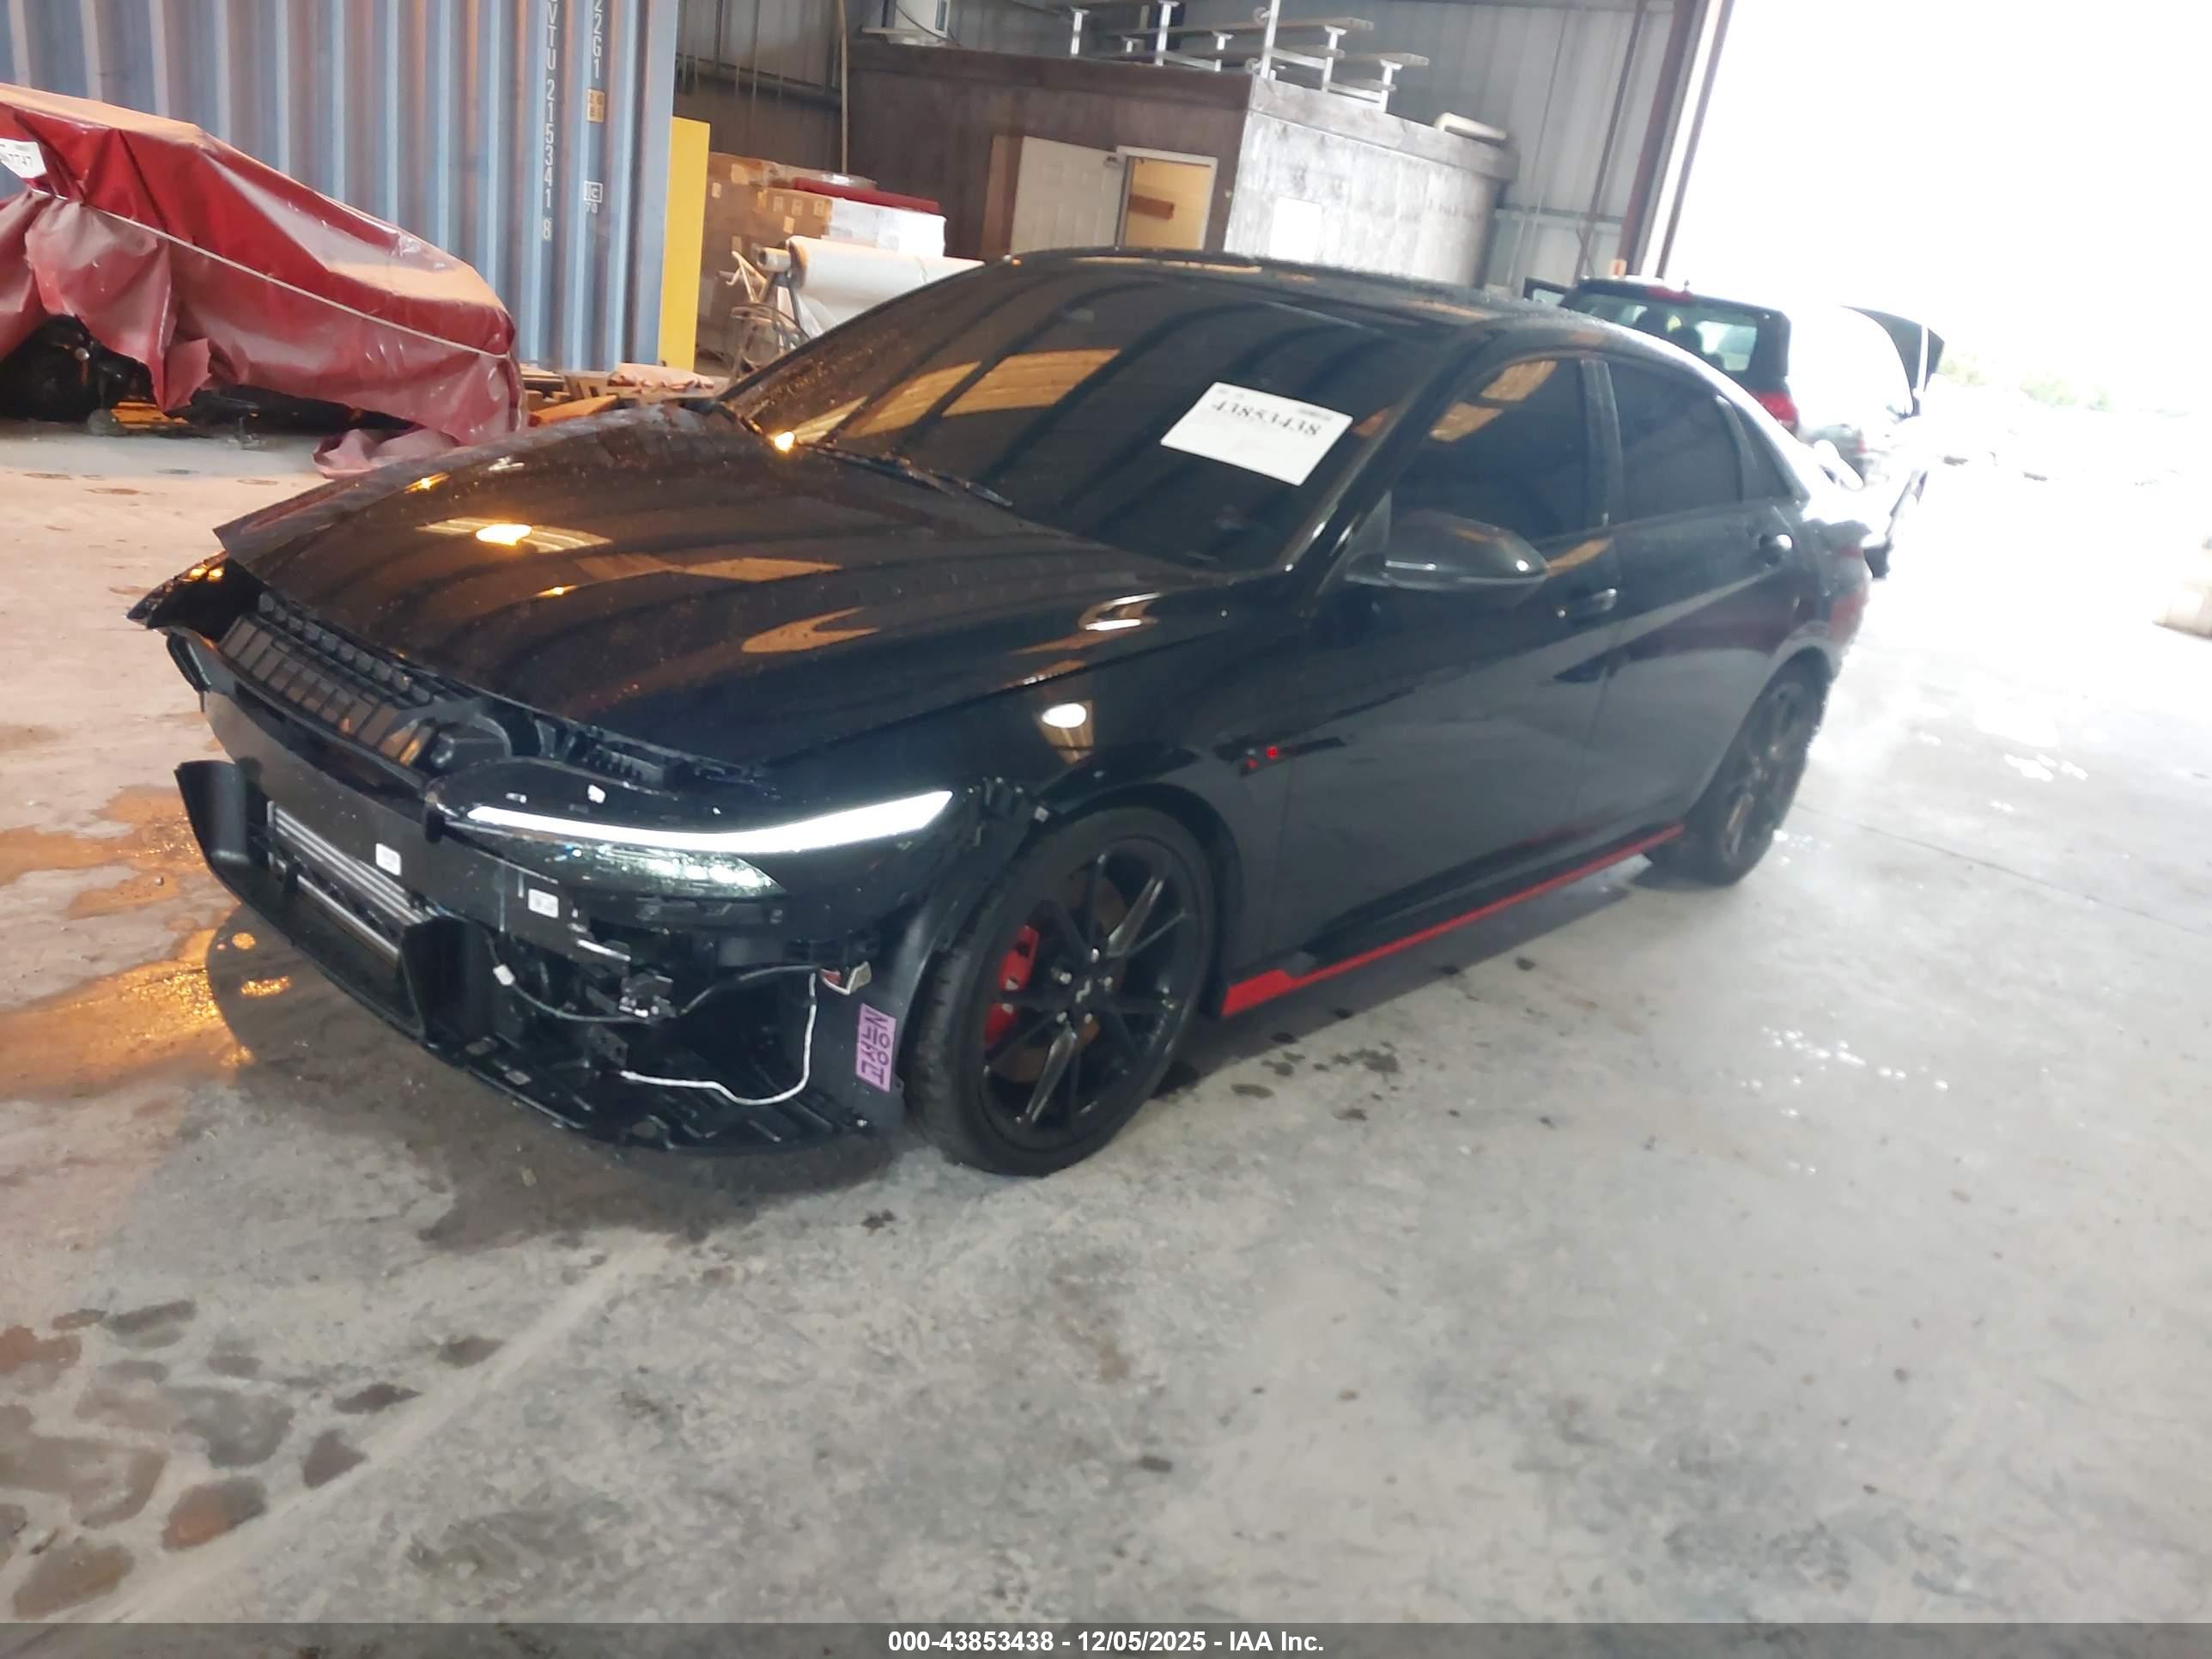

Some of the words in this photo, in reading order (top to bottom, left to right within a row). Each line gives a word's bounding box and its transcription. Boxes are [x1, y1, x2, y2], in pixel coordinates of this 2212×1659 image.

[546, 0, 558, 70] VTU
[544, 79, 556, 208] 215341
[543, 218, 553, 240] 8
[1212, 400, 1321, 435] 43853438
